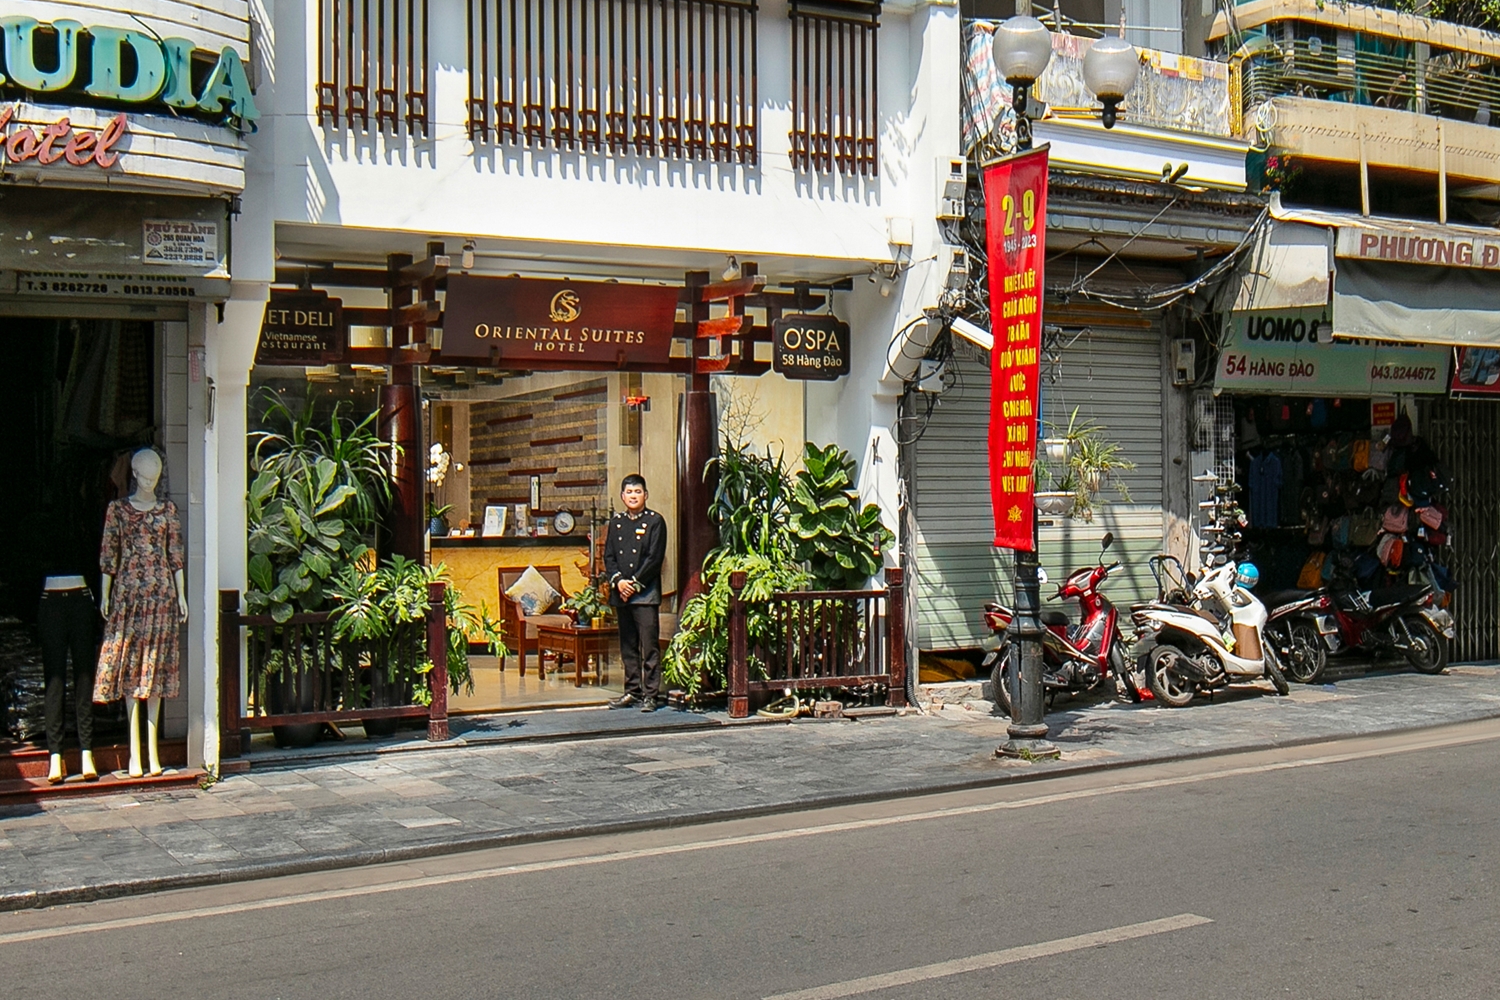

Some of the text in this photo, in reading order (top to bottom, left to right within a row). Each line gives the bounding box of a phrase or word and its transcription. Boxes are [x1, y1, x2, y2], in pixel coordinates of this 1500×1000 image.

[0, 15, 261, 133] UDIA
[1002, 189, 1035, 236] 2-9
[1360, 233, 1474, 266] PHƯƠNG
[294, 310, 333, 327] DELI
[265, 331, 318, 342] Vietnamese
[474, 323, 645, 344] ORIENTAL SUITES
[1247, 316, 1306, 342] UOMO
[261, 340, 327, 350] estaurant
[533, 341, 586, 353] HOTEL
[782, 353, 843, 369] 58 Hàng Đào
[1225, 355, 1315, 378] 54 HÀNG ĐÀO
[1370, 364, 1437, 382] 043.8244672
